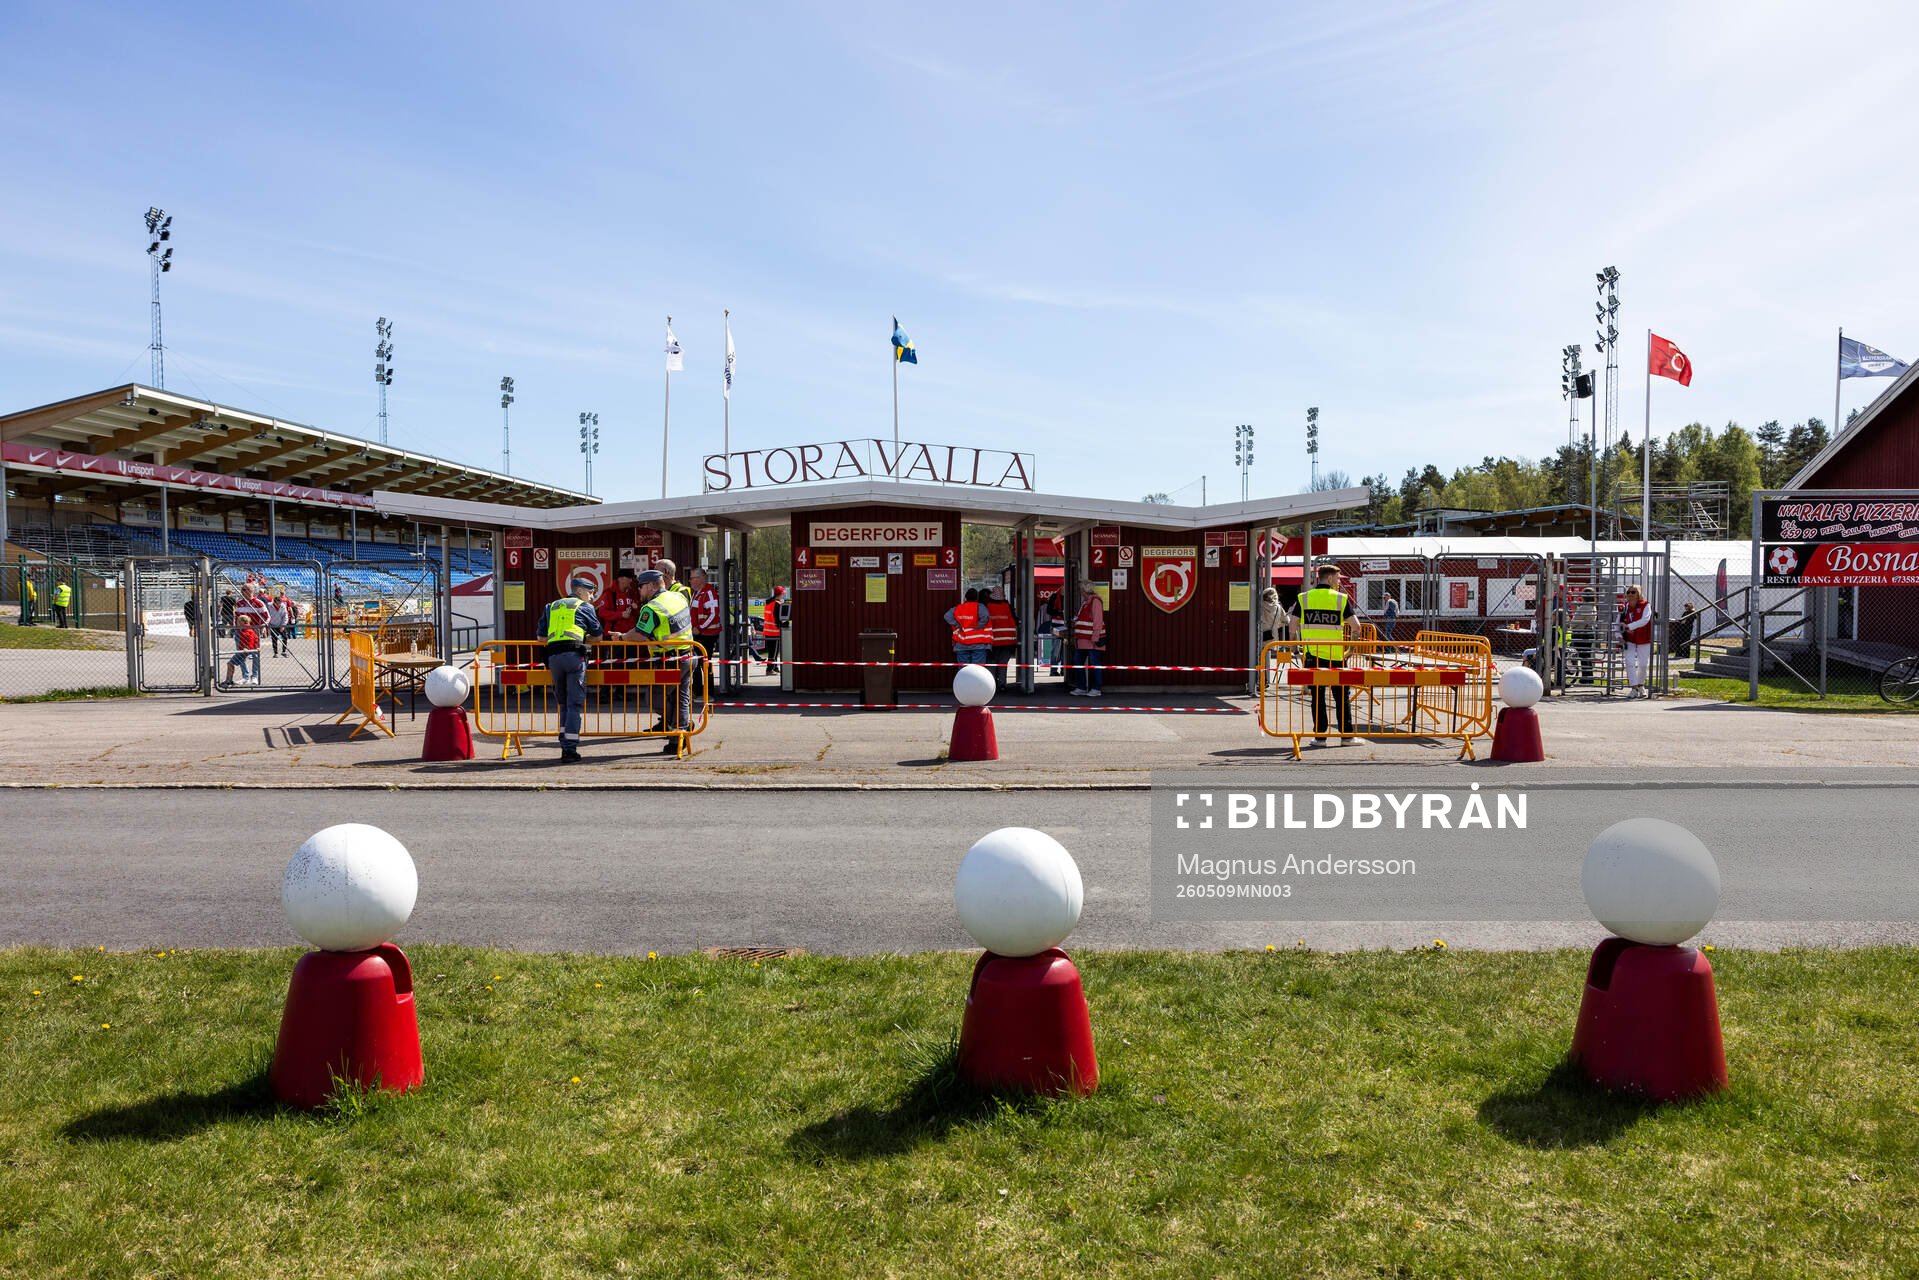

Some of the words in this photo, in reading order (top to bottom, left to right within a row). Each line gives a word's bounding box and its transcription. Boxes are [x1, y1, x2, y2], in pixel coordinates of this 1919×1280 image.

[127, 463, 154, 477] unisport
[704, 441, 867, 491] STORA
[873, 439, 1032, 490] VALLA
[1777, 504, 1801, 517] NYA
[1799, 503, 1852, 522] RALFS
[1853, 503, 1919, 521] PIZZERI
[814, 527, 919, 541] DEGERFORS
[924, 527, 938, 541] IF
[1780, 528, 1801, 539] 459
[1802, 528, 1818, 539] 99
[1820, 523, 1845, 536] PIZZA
[1841, 524, 1872, 538] SALLAD
[1869, 523, 1903, 538] HUSMAN
[510, 551, 518, 566] 6
[651, 550, 659, 564] 5
[797, 550, 807, 565] 4
[945, 549, 955, 564] 3
[1093, 549, 1103, 564] 2
[1235, 548, 1243, 564] 1
[1826, 545, 1919, 572] Bosna
[1767, 575, 1832, 584] RESTAURANG
[1833, 575, 1841, 584] &
[1843, 575, 1888, 584] PIZZERIA
[1305, 610, 1338, 624] VÄRD
